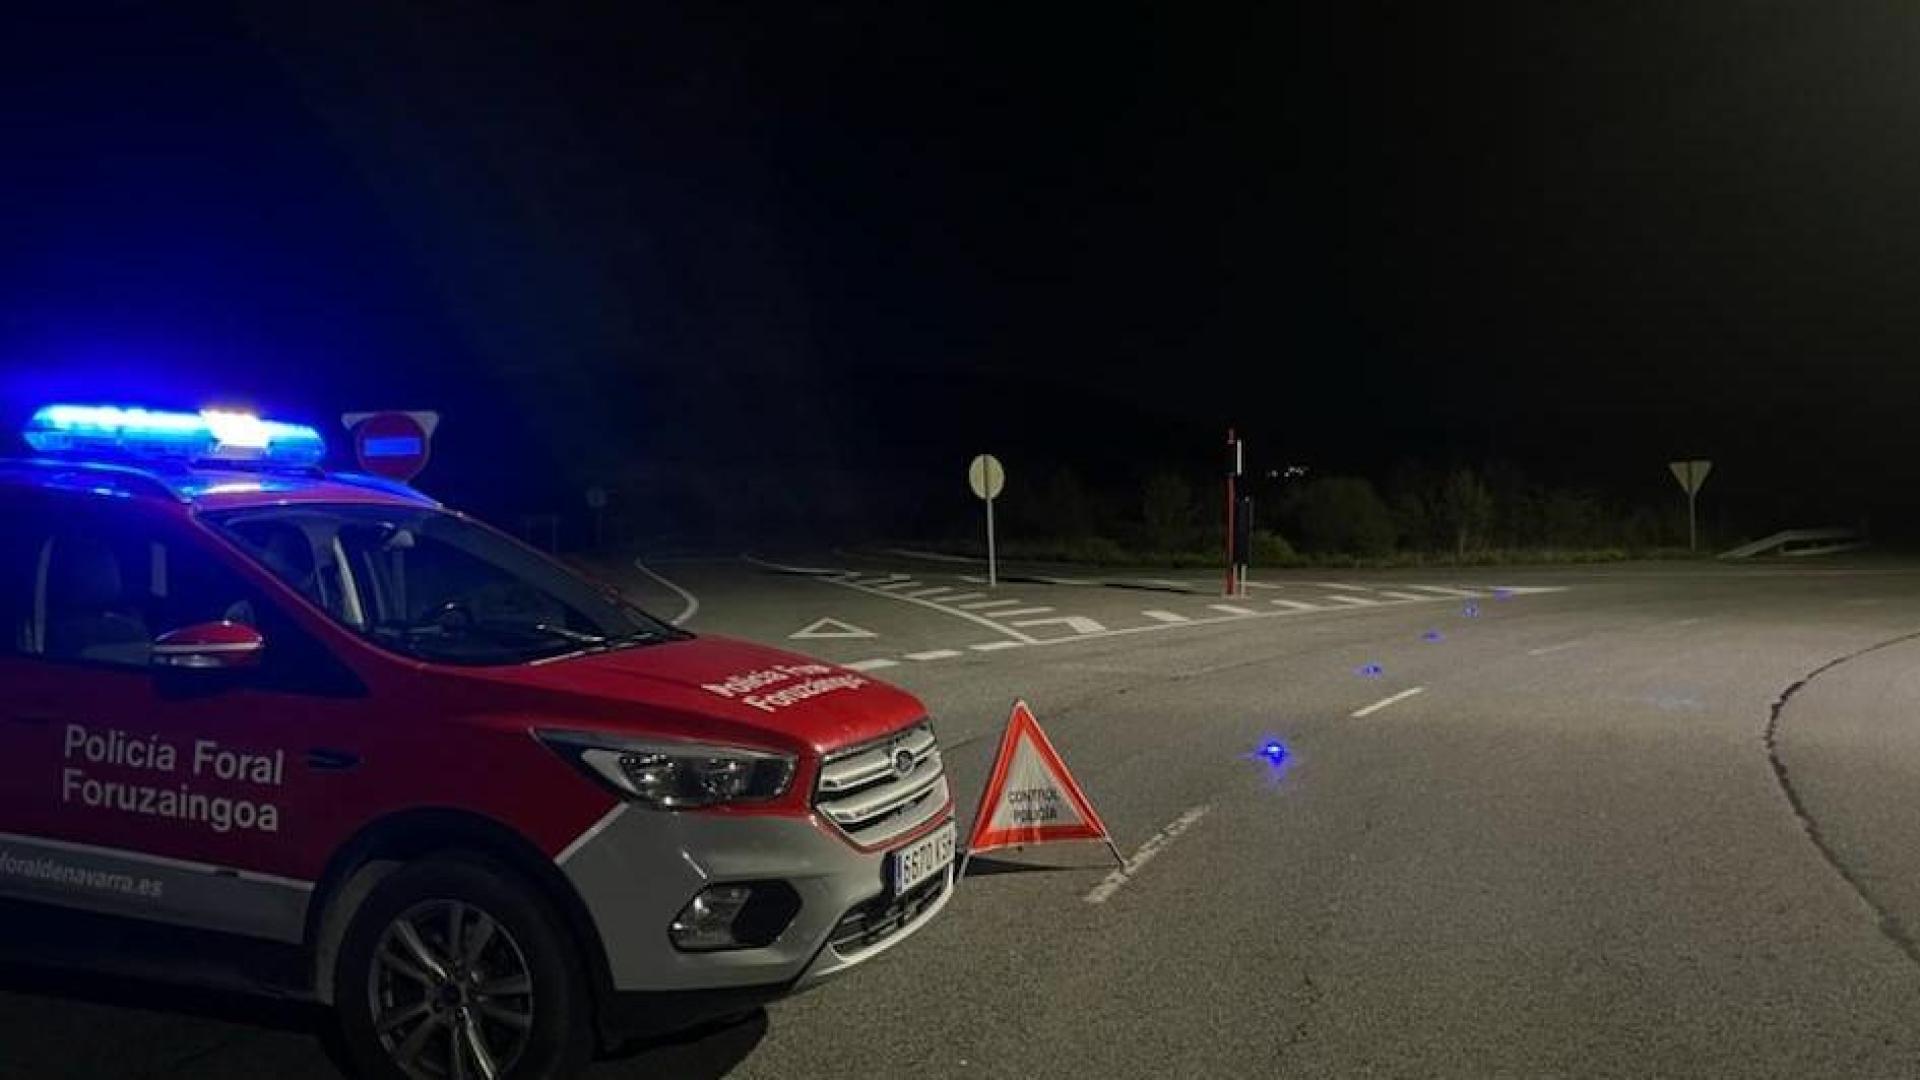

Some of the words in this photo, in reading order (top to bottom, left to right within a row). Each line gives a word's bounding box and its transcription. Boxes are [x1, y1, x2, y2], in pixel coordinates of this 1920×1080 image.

[64, 723, 176, 771] Policía
[193, 740, 284, 785] Foral
[62, 767, 279, 833] Foruzaingoa
